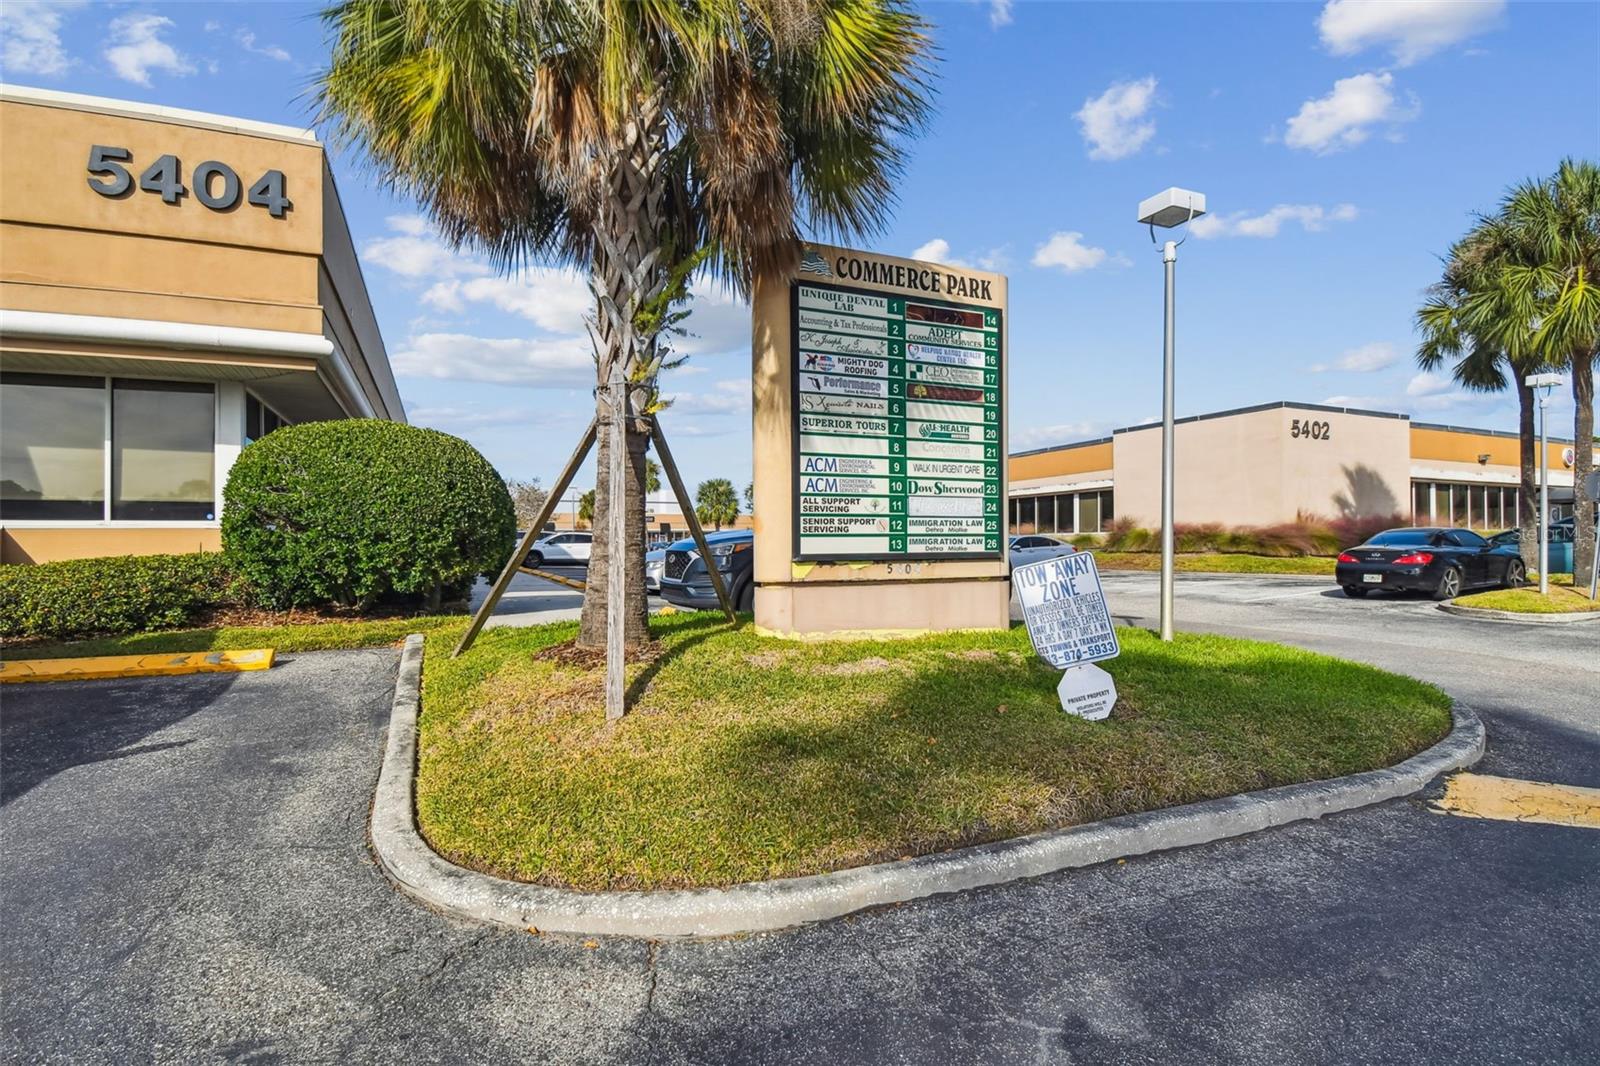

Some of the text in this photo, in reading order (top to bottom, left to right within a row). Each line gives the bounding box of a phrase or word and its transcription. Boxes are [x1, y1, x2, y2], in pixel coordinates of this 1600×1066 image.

[87, 144, 292, 217] 5404
[836, 256, 992, 300] COMMERCE PARK
[801, 289, 885, 308] UNIQUE DENTAL
[834, 302, 854, 311] LAB
[892, 302, 898, 312] 1
[800, 315, 887, 333] Accounting & Tax Professionals
[986, 316, 996, 325] 14
[892, 325, 899, 335] 2
[928, 327, 963, 339] ADEPT
[908, 334, 982, 347] COMMUNITY SERVICES
[986, 337, 996, 346] 15
[892, 345, 899, 354] 3
[837, 357, 867, 367] MIGHTY
[868, 360, 884, 368] DOG
[986, 356, 995, 365] 16
[845, 366, 877, 375] ROOFING
[892, 365, 899, 374] 4
[823, 376, 881, 392] Performance
[986, 375, 995, 383] 17
[893, 384, 899, 394] 5
[986, 393, 996, 401] 18
[893, 404, 899, 413] 6
[986, 412, 995, 420] 19
[802, 417, 886, 431] SUPERIOR TOURS
[893, 423, 899, 432] 7
[940, 424, 970, 433] HEALTH
[986, 430, 996, 438] 20
[1291, 419, 1329, 440] 5402
[893, 442, 900, 452] 8
[986, 449, 996, 457] 21
[805, 457, 838, 472] ACM
[893, 462, 900, 472] 9
[913, 463, 980, 474] WALK IN URGENT CARE
[986, 467, 996, 475] 22
[805, 478, 838, 492] ACM
[891, 482, 902, 491] 10
[934, 481, 984, 495] Sherwood
[986, 485, 997, 494] 23
[892, 501, 902, 511] 11
[986, 503, 997, 512] 24
[891, 521, 902, 530] 12
[986, 521, 997, 530] 25
[891, 540, 902, 549] 13
[986, 539, 997, 548] 26
[1017, 555, 1089, 588] TOW AWAY
[1040, 577, 1080, 602] ZONE
[1026, 592, 1100, 616] UNAUTHORIZED VEHICLES
[1077, 605, 1085, 616] BE
[1033, 624, 1048, 636] AWAY
[1057, 617, 1081, 631] OWNERS
[1082, 612, 1106, 626] EXPENSE
[1036, 636, 1044, 646] 24
[1057, 633, 1062, 642] A
[1062, 629, 1073, 641] DAY
[1079, 625, 1094, 637] DAYS
[1049, 641, 1072, 653] TOWING
[1073, 639, 1078, 648] &
[1078, 633, 1112, 646] TRANSPORT
[1068, 690, 1109, 704] PRIVATE PROPERTY
